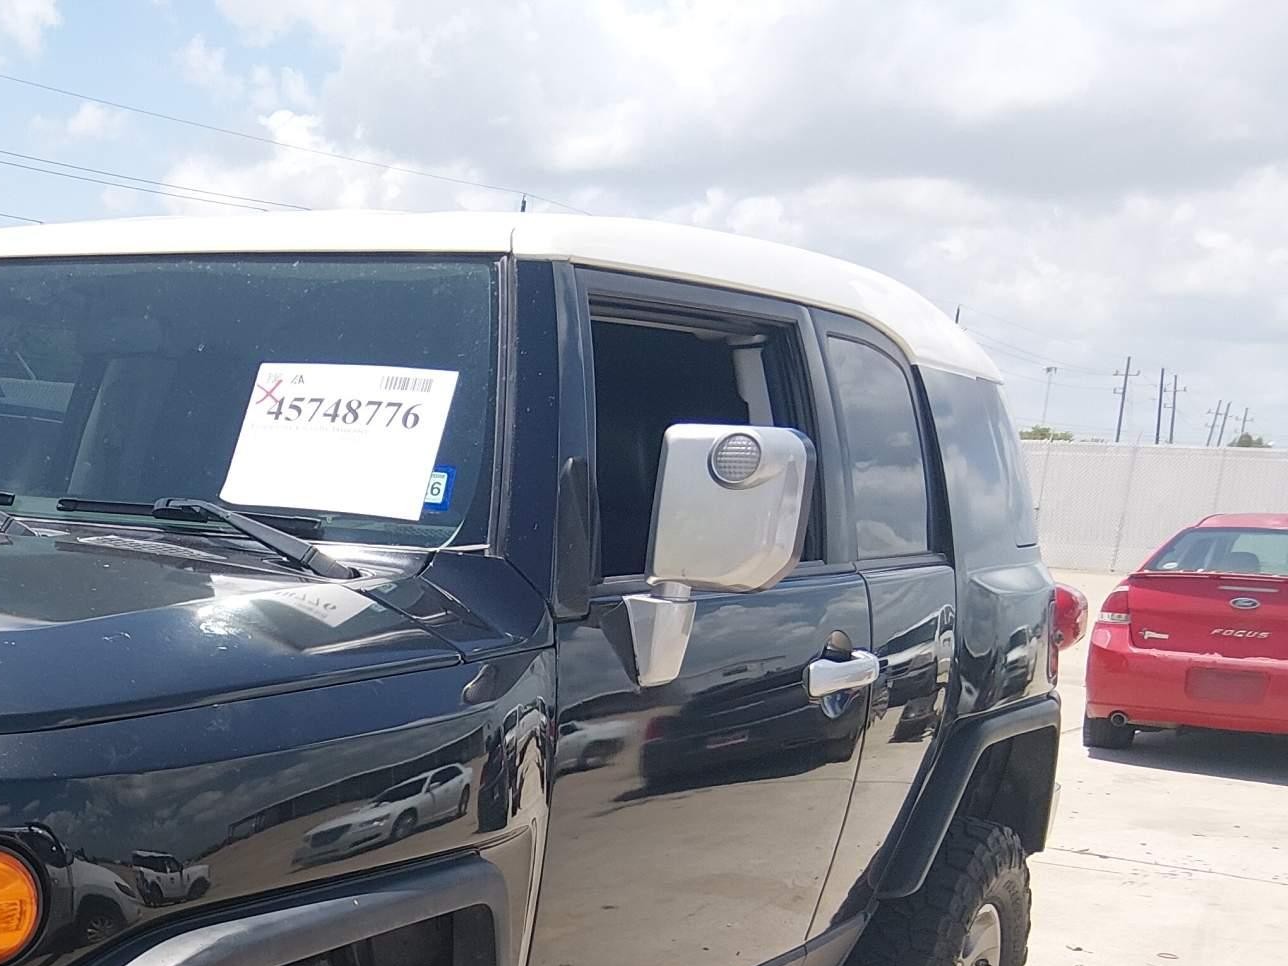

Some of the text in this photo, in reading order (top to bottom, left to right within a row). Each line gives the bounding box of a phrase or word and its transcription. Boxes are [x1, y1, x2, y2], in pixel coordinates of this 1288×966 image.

[267, 396, 423, 430] 45748776
[427, 481, 442, 497] 6
[1210, 628, 1271, 639] FOCUS
